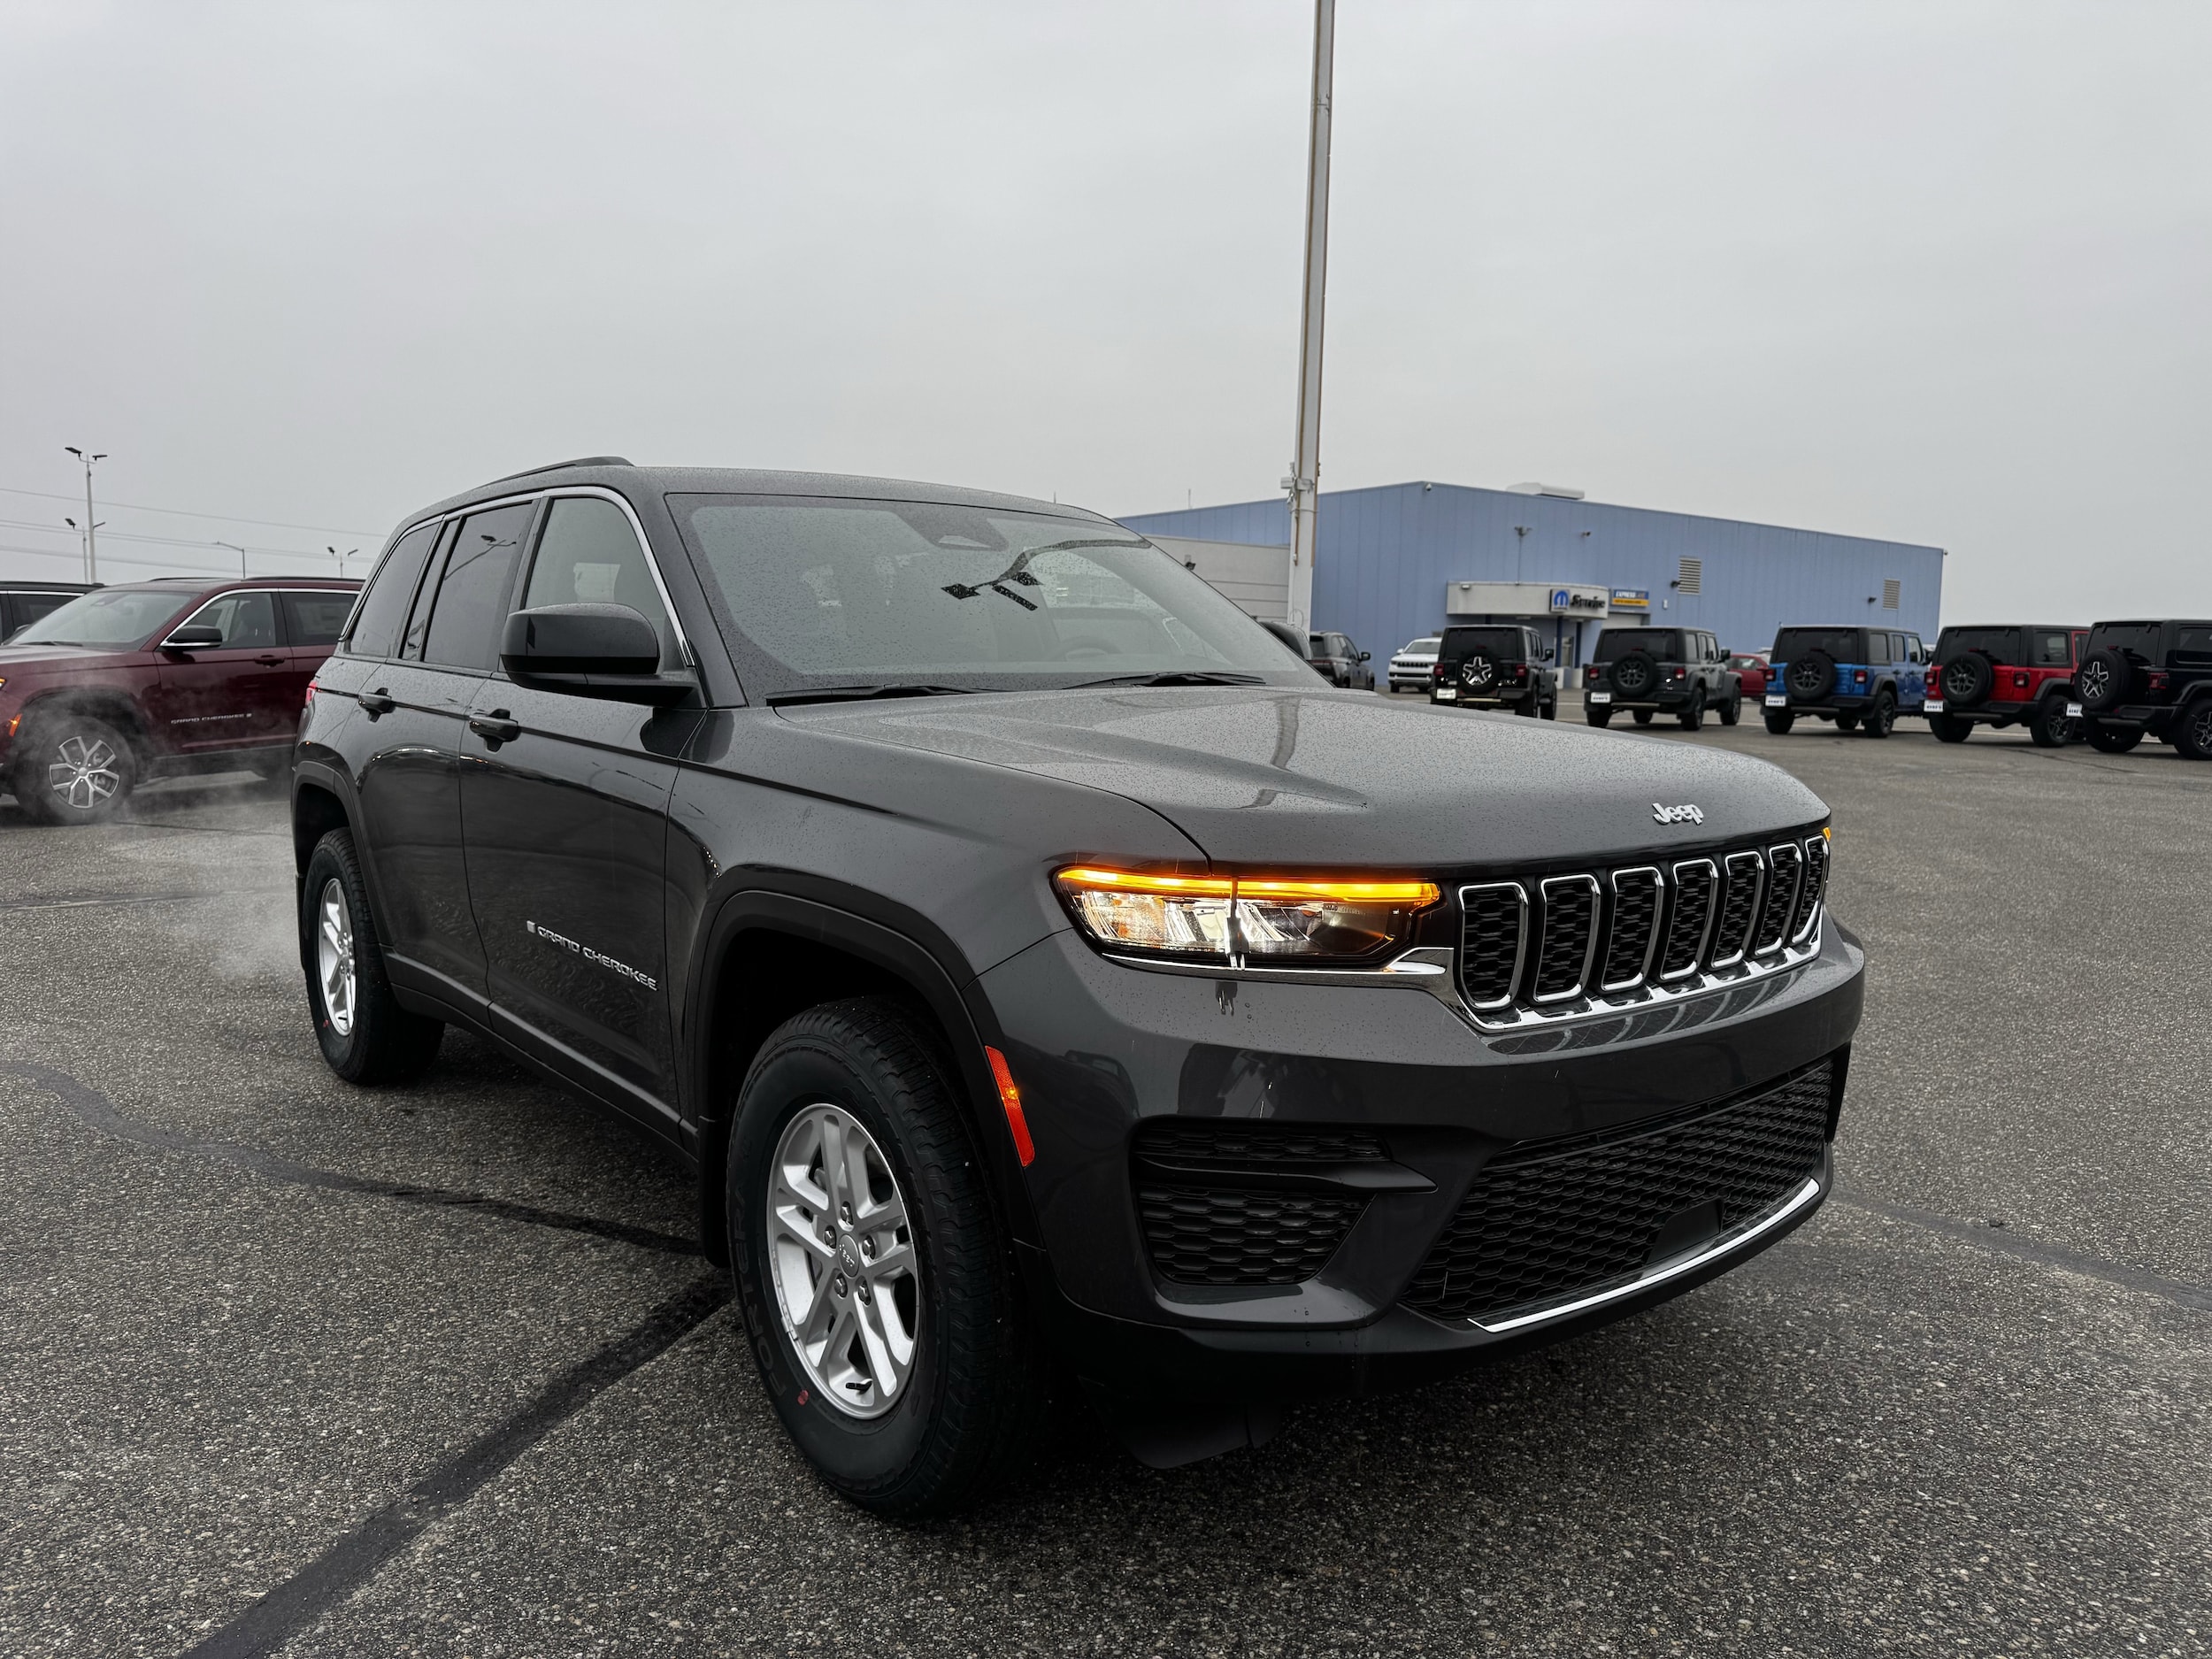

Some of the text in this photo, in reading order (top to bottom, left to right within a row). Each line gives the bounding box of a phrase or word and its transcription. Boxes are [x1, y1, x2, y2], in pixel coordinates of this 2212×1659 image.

[1652, 803, 1704, 825] Jeep
[537, 926, 657, 991] GRAND CHEROKEE
[735, 1186, 785, 1396] FORTERA
